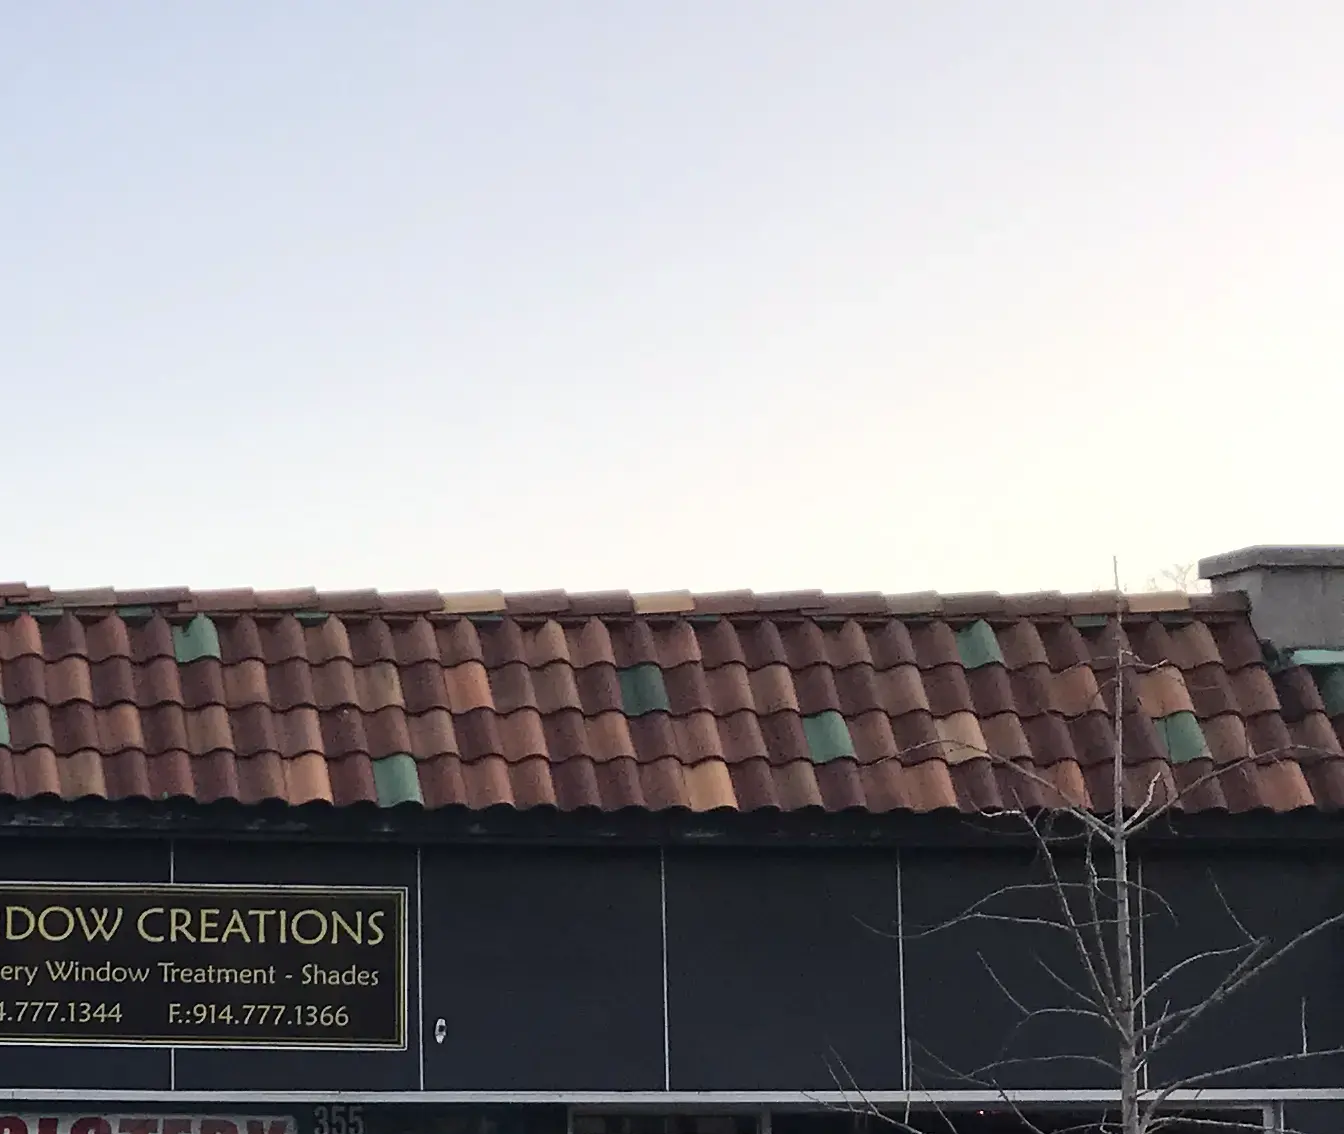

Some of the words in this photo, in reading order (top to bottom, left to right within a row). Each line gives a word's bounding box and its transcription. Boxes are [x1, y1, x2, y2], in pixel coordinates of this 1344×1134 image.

[137, 907, 385, 946] CREATIONS
[45, 960, 150, 982] Window
[158, 962, 276, 985] Treatment
[301, 963, 379, 986] Shades
[168, 1002, 349, 1027] F.:914.777.1366
